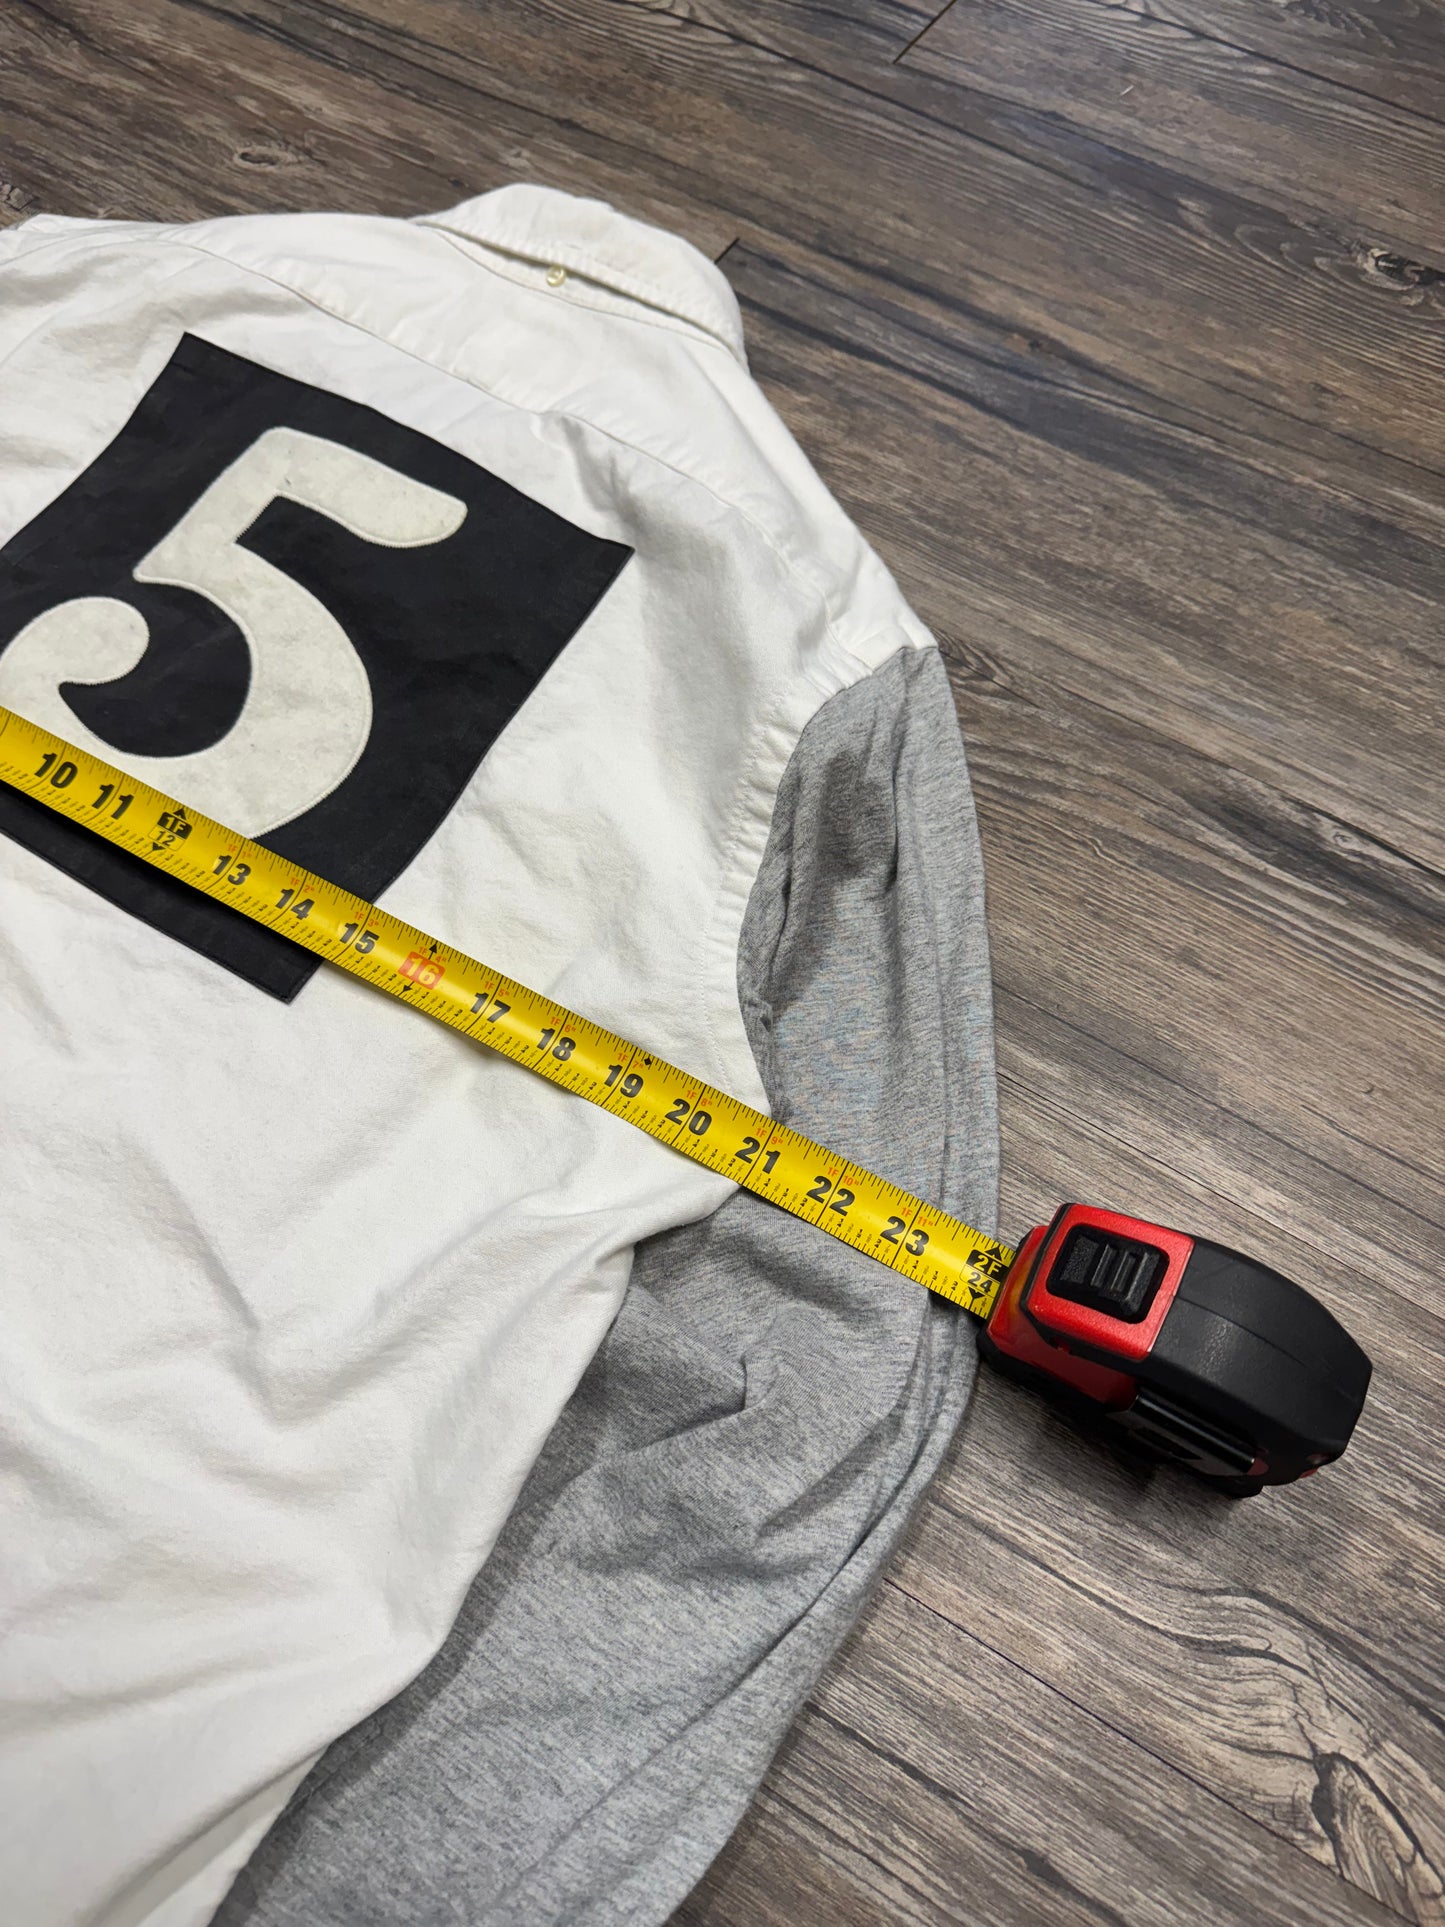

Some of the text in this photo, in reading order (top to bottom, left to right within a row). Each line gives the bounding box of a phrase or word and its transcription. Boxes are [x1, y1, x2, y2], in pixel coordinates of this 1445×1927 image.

[0, 427, 467, 838] 5
[34, 752, 78, 788] 10
[92, 783, 135, 820] 11
[157, 830, 176, 847] 12
[165, 816, 187, 834] 1F
[212, 855, 251, 885] 13
[275, 888, 315, 920] 14
[339, 922, 380, 954] 15
[405, 957, 440, 986] 16
[470, 992, 511, 1023] 17
[537, 1028, 576, 1061] 18
[604, 1064, 644, 1098] 19
[664, 1098, 712, 1136] 20
[734, 1136, 781, 1174] 21
[806, 1175, 855, 1217] 22
[880, 1215, 929, 1256] 23
[975, 1254, 1002, 1276] 2F
[967, 1271, 992, 1293] 24
